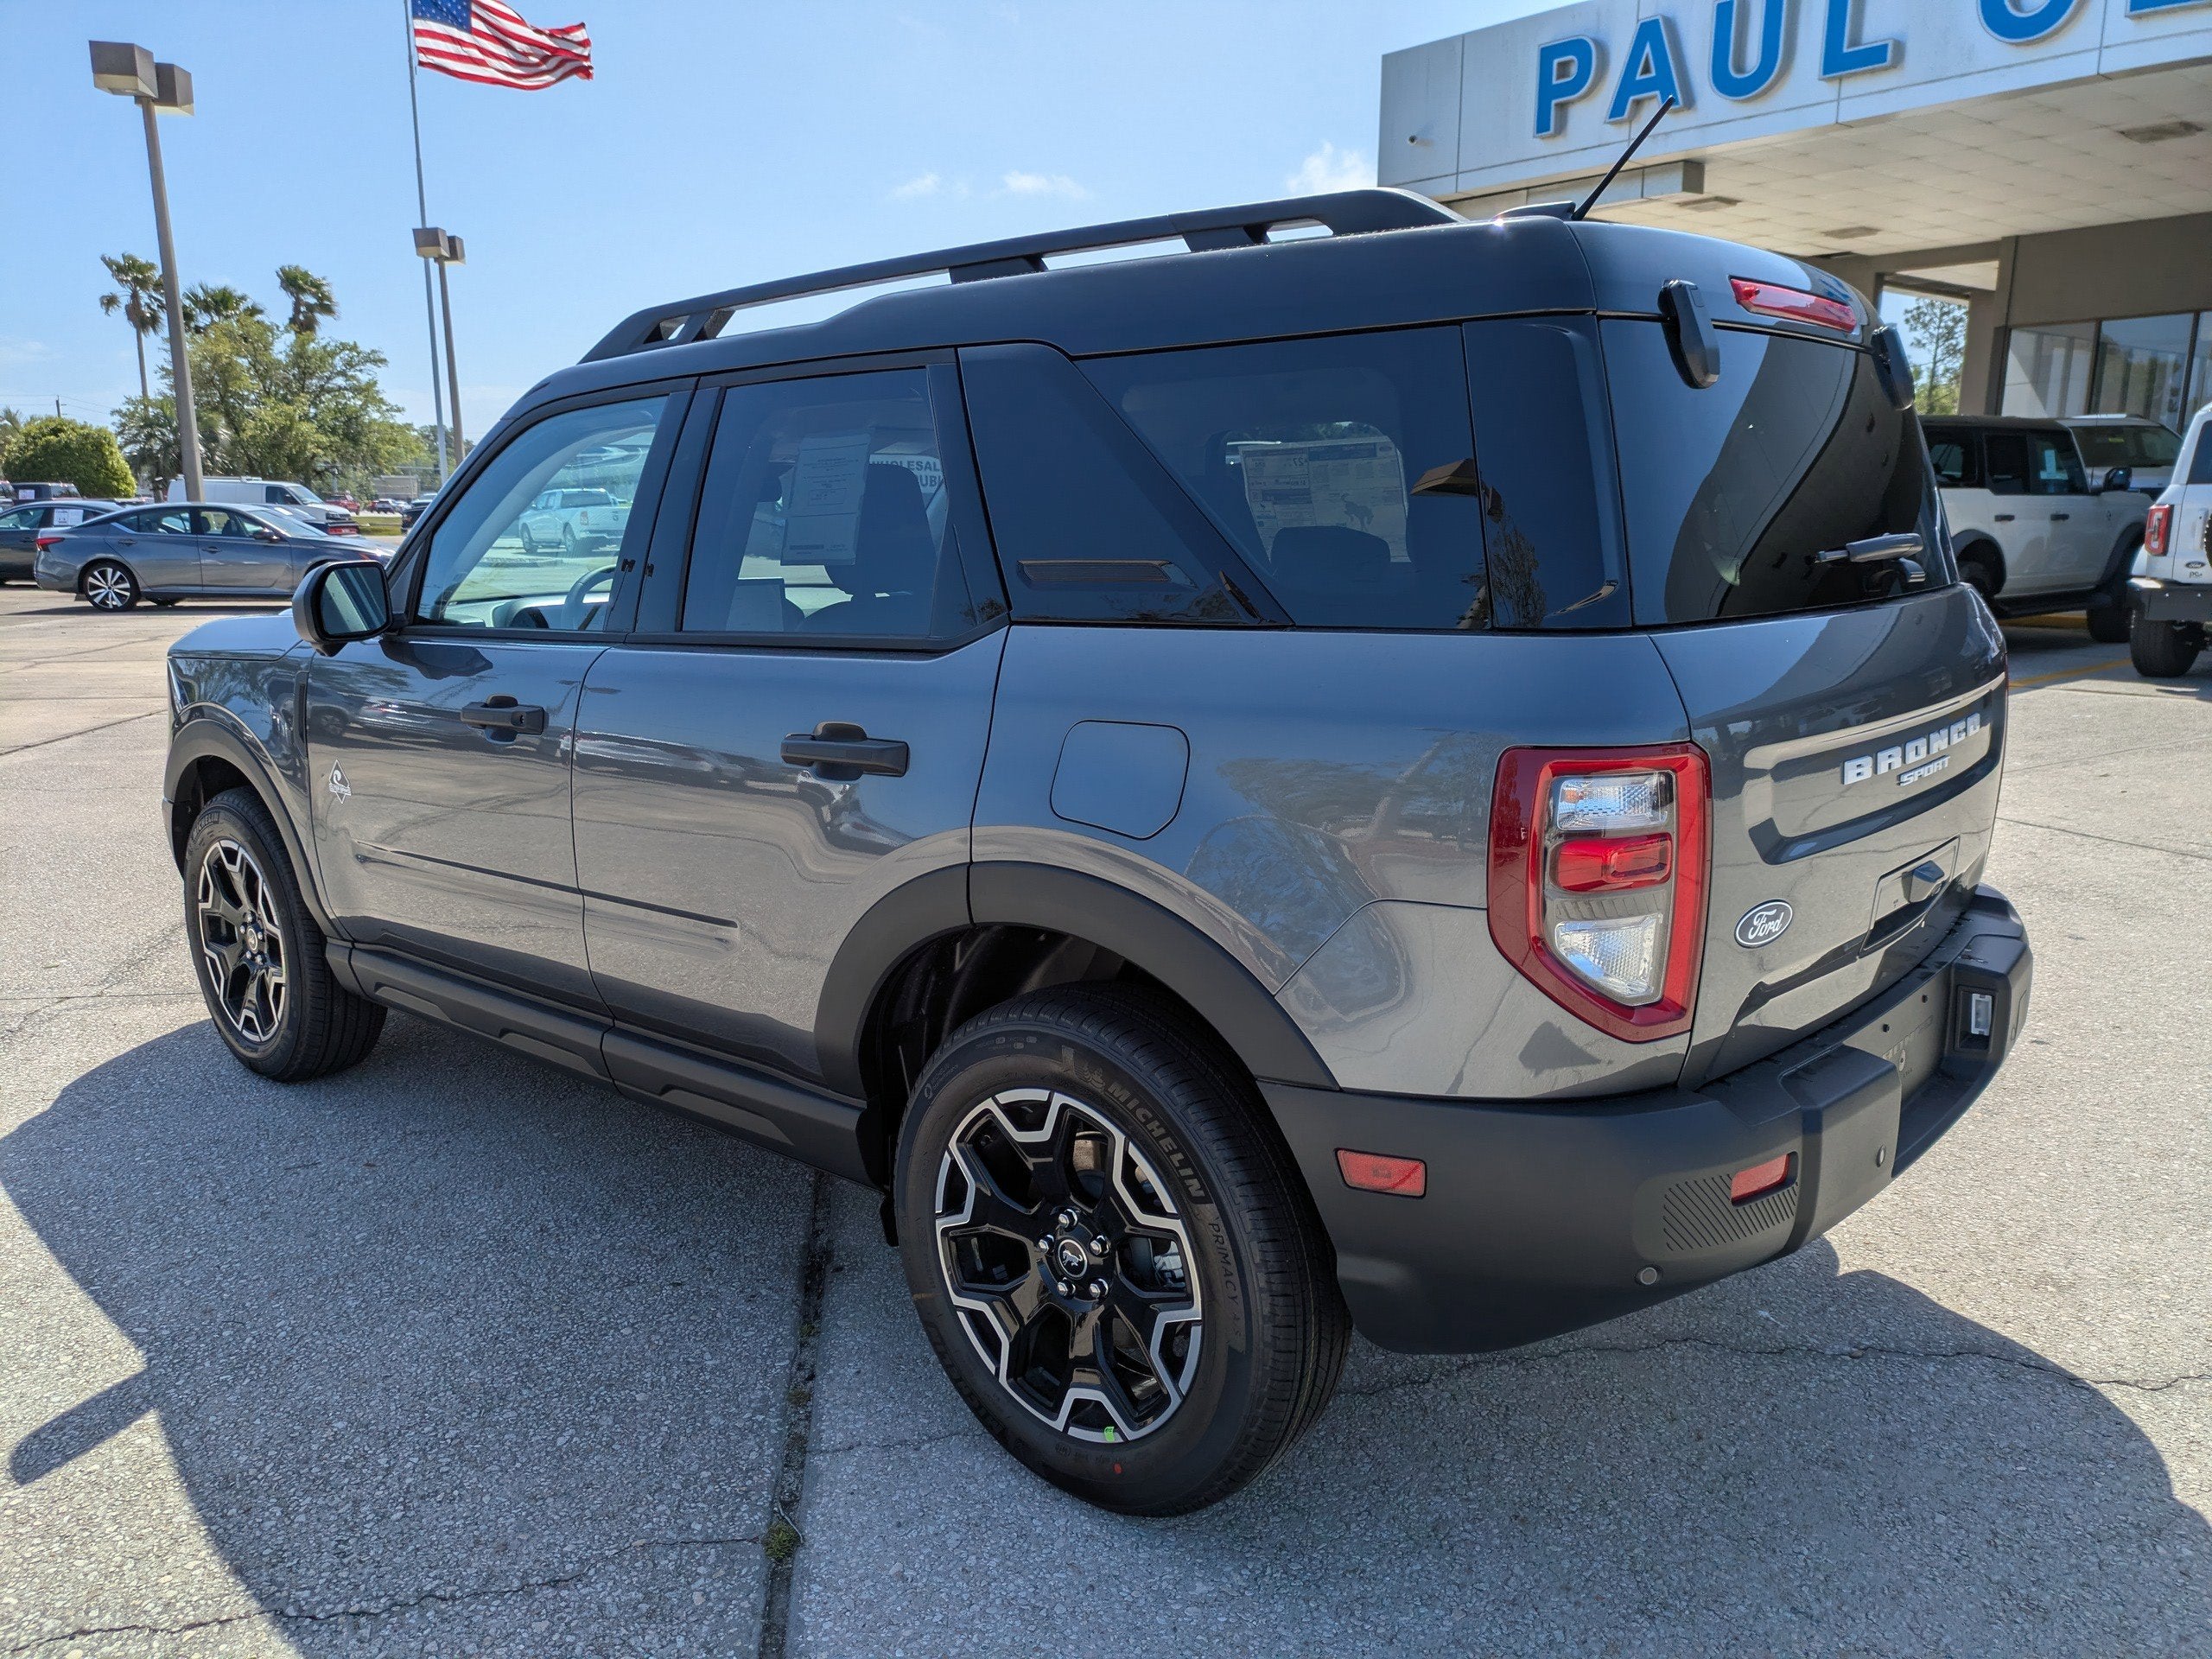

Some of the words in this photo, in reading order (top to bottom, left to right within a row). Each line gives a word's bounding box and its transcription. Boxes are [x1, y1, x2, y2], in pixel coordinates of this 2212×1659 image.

[1533, 0, 1900, 138] PAUL
[1843, 713, 1980, 785] BRONCO
[1899, 755, 1950, 786] SPORT
[1747, 908, 1784, 940] Ford
[1107, 1082, 1205, 1198] MICHELIN
[1208, 1223, 1239, 1306] PRIMACY
